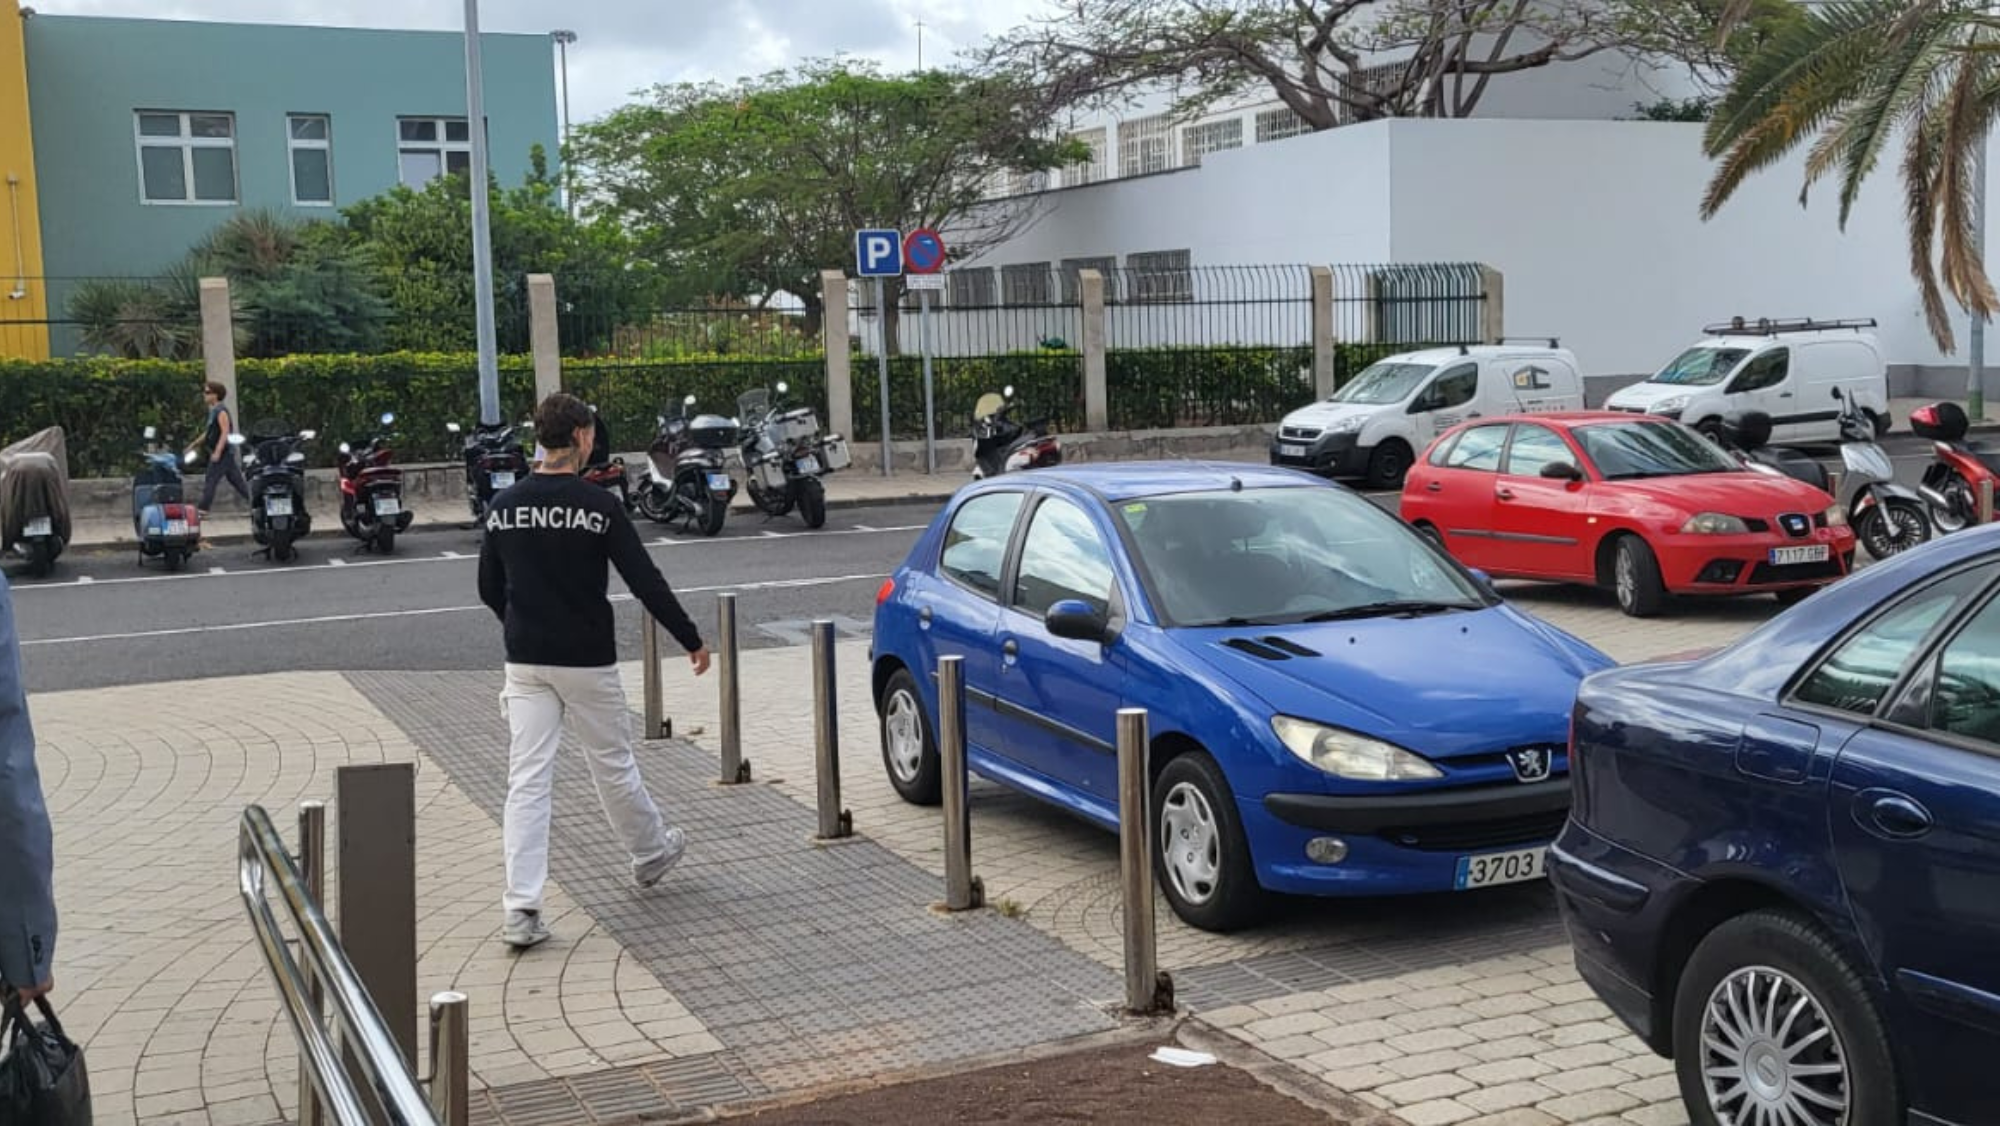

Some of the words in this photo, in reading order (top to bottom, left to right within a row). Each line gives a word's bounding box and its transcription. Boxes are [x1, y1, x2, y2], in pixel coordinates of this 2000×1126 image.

[867, 237, 891, 269] P
[486, 506, 610, 534] ALENCIAG
[1473, 853, 1533, 883] 3703
